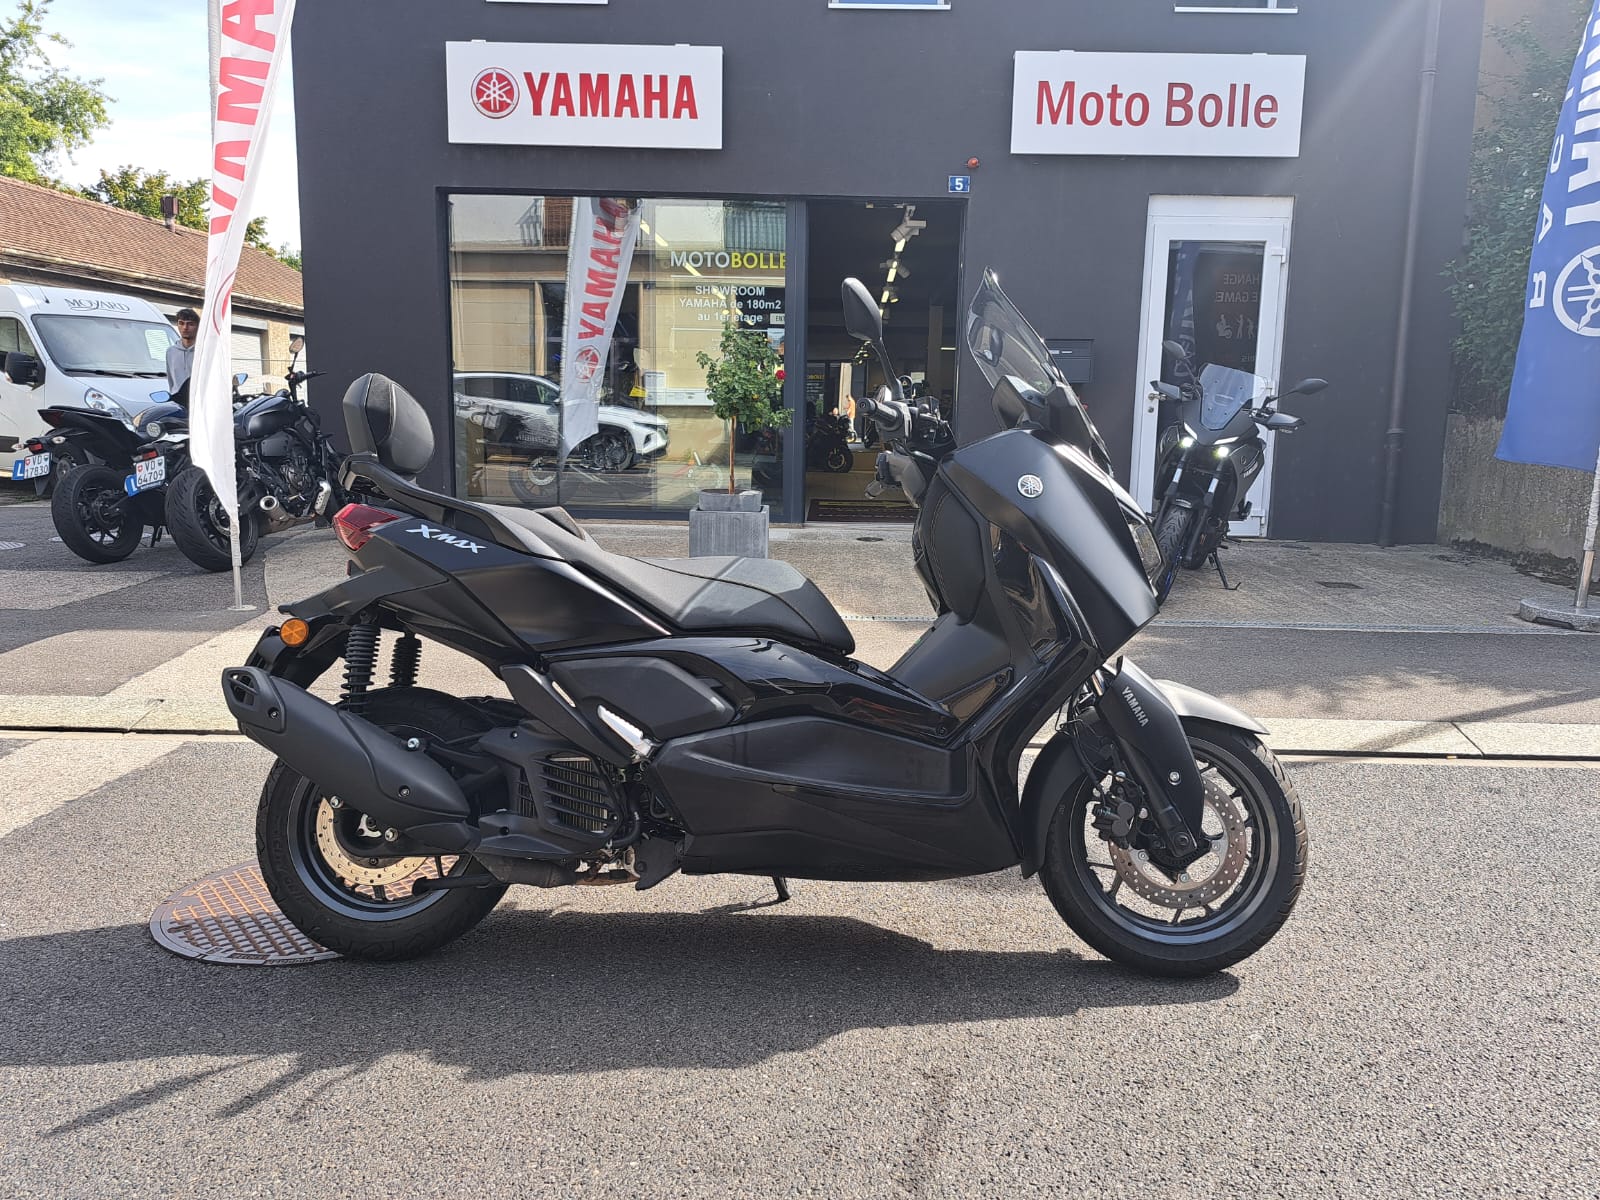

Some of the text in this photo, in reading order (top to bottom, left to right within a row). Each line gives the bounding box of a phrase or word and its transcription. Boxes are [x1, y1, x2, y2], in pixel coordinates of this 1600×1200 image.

[523, 72, 698, 119] YAMAHA
[1036, 80, 1278, 128] Moto Bolle
[955, 178, 963, 190] 5
[695, 285, 765, 296] SHOWROOM
[680, 298, 781, 309] YAMAHA de 180m2
[697, 313, 710, 321] au
[32, 455, 42, 466] VD
[145, 461, 156, 472] VD
[17, 462, 24, 477] L
[138, 469, 164, 484] 64709
[130, 477, 138, 492] L
[1121, 686, 1149, 727] YAMAHA
